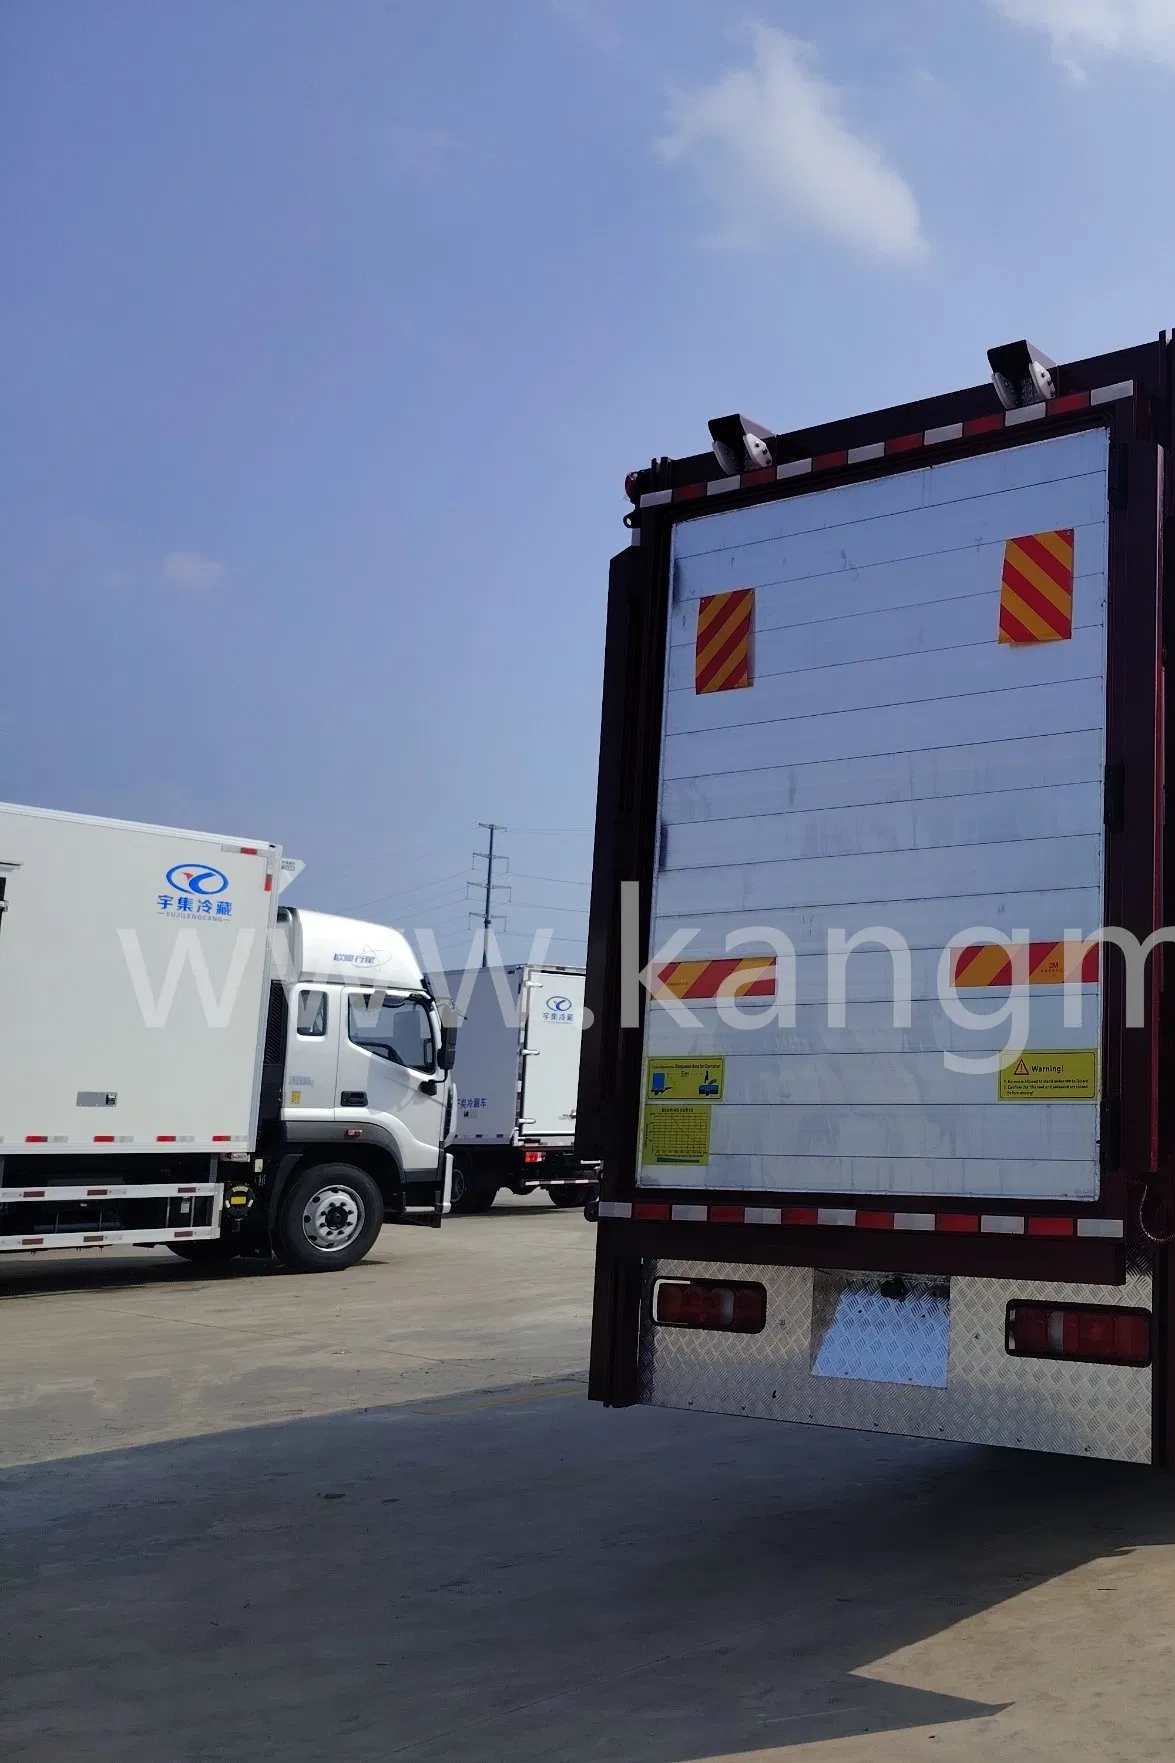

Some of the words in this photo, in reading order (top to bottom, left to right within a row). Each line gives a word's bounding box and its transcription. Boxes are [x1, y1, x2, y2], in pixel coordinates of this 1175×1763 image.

[157, 895, 232, 916] 宇集冷藏
[166, 912, 223, 922] YUJILENGCANG
[1031, 1065, 1064, 1073] Warning!
